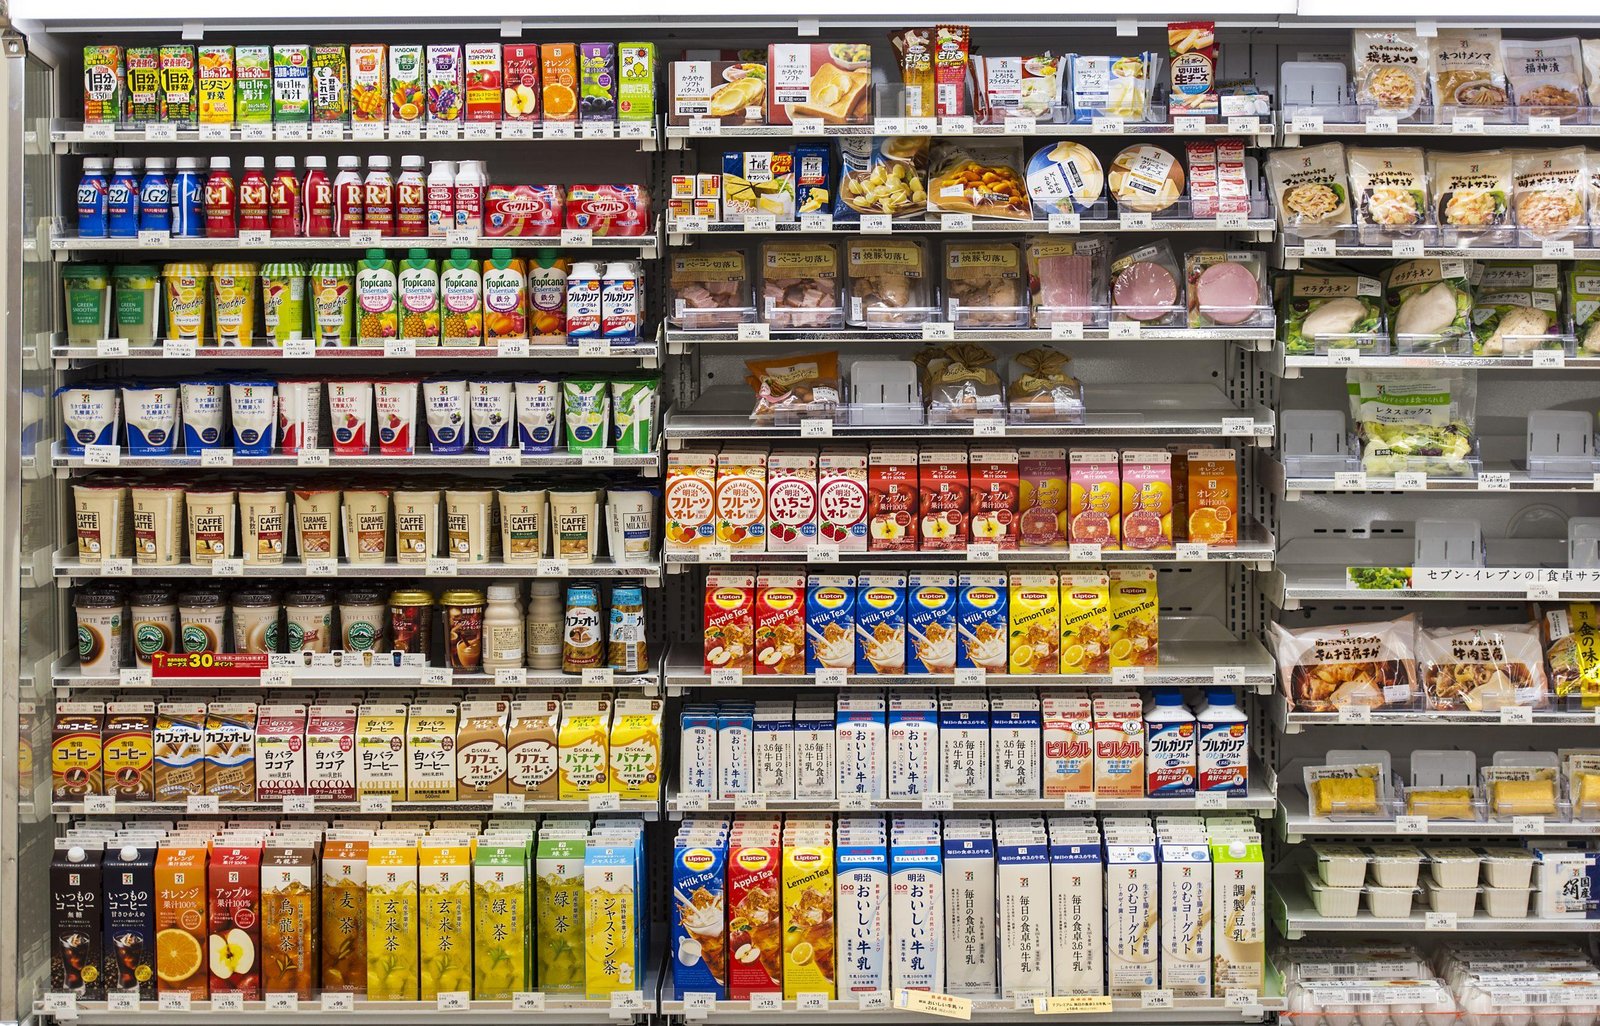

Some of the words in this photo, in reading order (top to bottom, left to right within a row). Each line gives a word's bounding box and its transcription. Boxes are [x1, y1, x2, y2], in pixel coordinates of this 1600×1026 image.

[938, 51, 965, 60] さける
[1366, 53, 1418, 65] 穂先メンマ
[1439, 52, 1492, 61] 味つけメンマ
[508, 59, 533, 67] アップル
[544, 58, 571, 67] オレンジ
[584, 59, 609, 67] グレープ
[1525, 63, 1559, 74] 福神漬
[1175, 74, 1209, 85] 生チーズ
[201, 81, 231, 90] ビタミン
[243, 90, 264, 99] 青汁
[772, 165, 791, 173] 6個入
[1368, 177, 1414, 187] ポテトサラダ
[1449, 179, 1498, 190] ポテトサラダ
[507, 202, 538, 212] ヤクルト
[1040, 246, 1067, 254] ベーコン
[863, 252, 910, 261] 焼豚切落し
[686, 260, 739, 269] ベーコン切落し
[360, 278, 392, 288] Tropicana
[402, 278, 435, 287] Tropicana
[1302, 284, 1351, 293] サラダチキン
[569, 293, 599, 302] ブルガリア
[604, 293, 634, 302] ブルガリア
[170, 297, 204, 312] Smoothie
[1376, 406, 1433, 416] レタスミックス
[674, 483, 687, 495] MEIJI
[696, 485, 707, 495] LAIT
[1197, 490, 1228, 498] オレンジ
[672, 498, 710, 509] フルーツ
[774, 496, 810, 509] いちご
[878, 494, 908, 503] アップル
[197, 516, 222, 524] CAFFÈ
[198, 524, 222, 532] LATTE
[709, 613, 733, 627] Apple
[734, 608, 748, 620] Tea
[812, 612, 828, 626] Milk
[829, 608, 845, 620] Tea
[1014, 610, 1040, 626] Lemon
[1042, 606, 1056, 618] Tea
[1315, 647, 1380, 661] キムチ豆腐チゲ
[1453, 648, 1503, 661] 牛肉豆腐
[189, 653, 213, 668] 30
[156, 732, 202, 744] カフェオーレ
[1046, 741, 1092, 758] ピルクル
[1152, 739, 1193, 752] ブルガリア
[58, 749, 96, 760] コーヒー
[265, 750, 293, 760] 白バラ
[464, 754, 498, 764] カフェ
[565, 754, 601, 763] バナナ
[265, 760, 294, 770] ココア
[695, 736, 705, 788] おいしい牛乳
[259, 780, 301, 789] COCOA
[854, 873, 872, 883] 明治
[1563, 880, 1580, 899] 絹
[1580, 877, 1590, 898] 国産
[54, 892, 94, 902] いつもの
[160, 888, 199, 899] オレンジ
[215, 888, 252, 898] アップル
[56, 902, 94, 911] コーヒー
[339, 891, 354, 935] 麦茶
[1232, 884, 1246, 942] 調製豆乳
[492, 899, 508, 942] 緑茶
[1128, 882, 1140, 956] のむヨーグルト
[384, 899, 400, 951] 玄米茶
[856, 884, 871, 971] おいしい牛乳
[603, 898, 618, 976] ジャスミン茶
[1020, 895, 1032, 973] 毎日の食卓3.6牛乳
